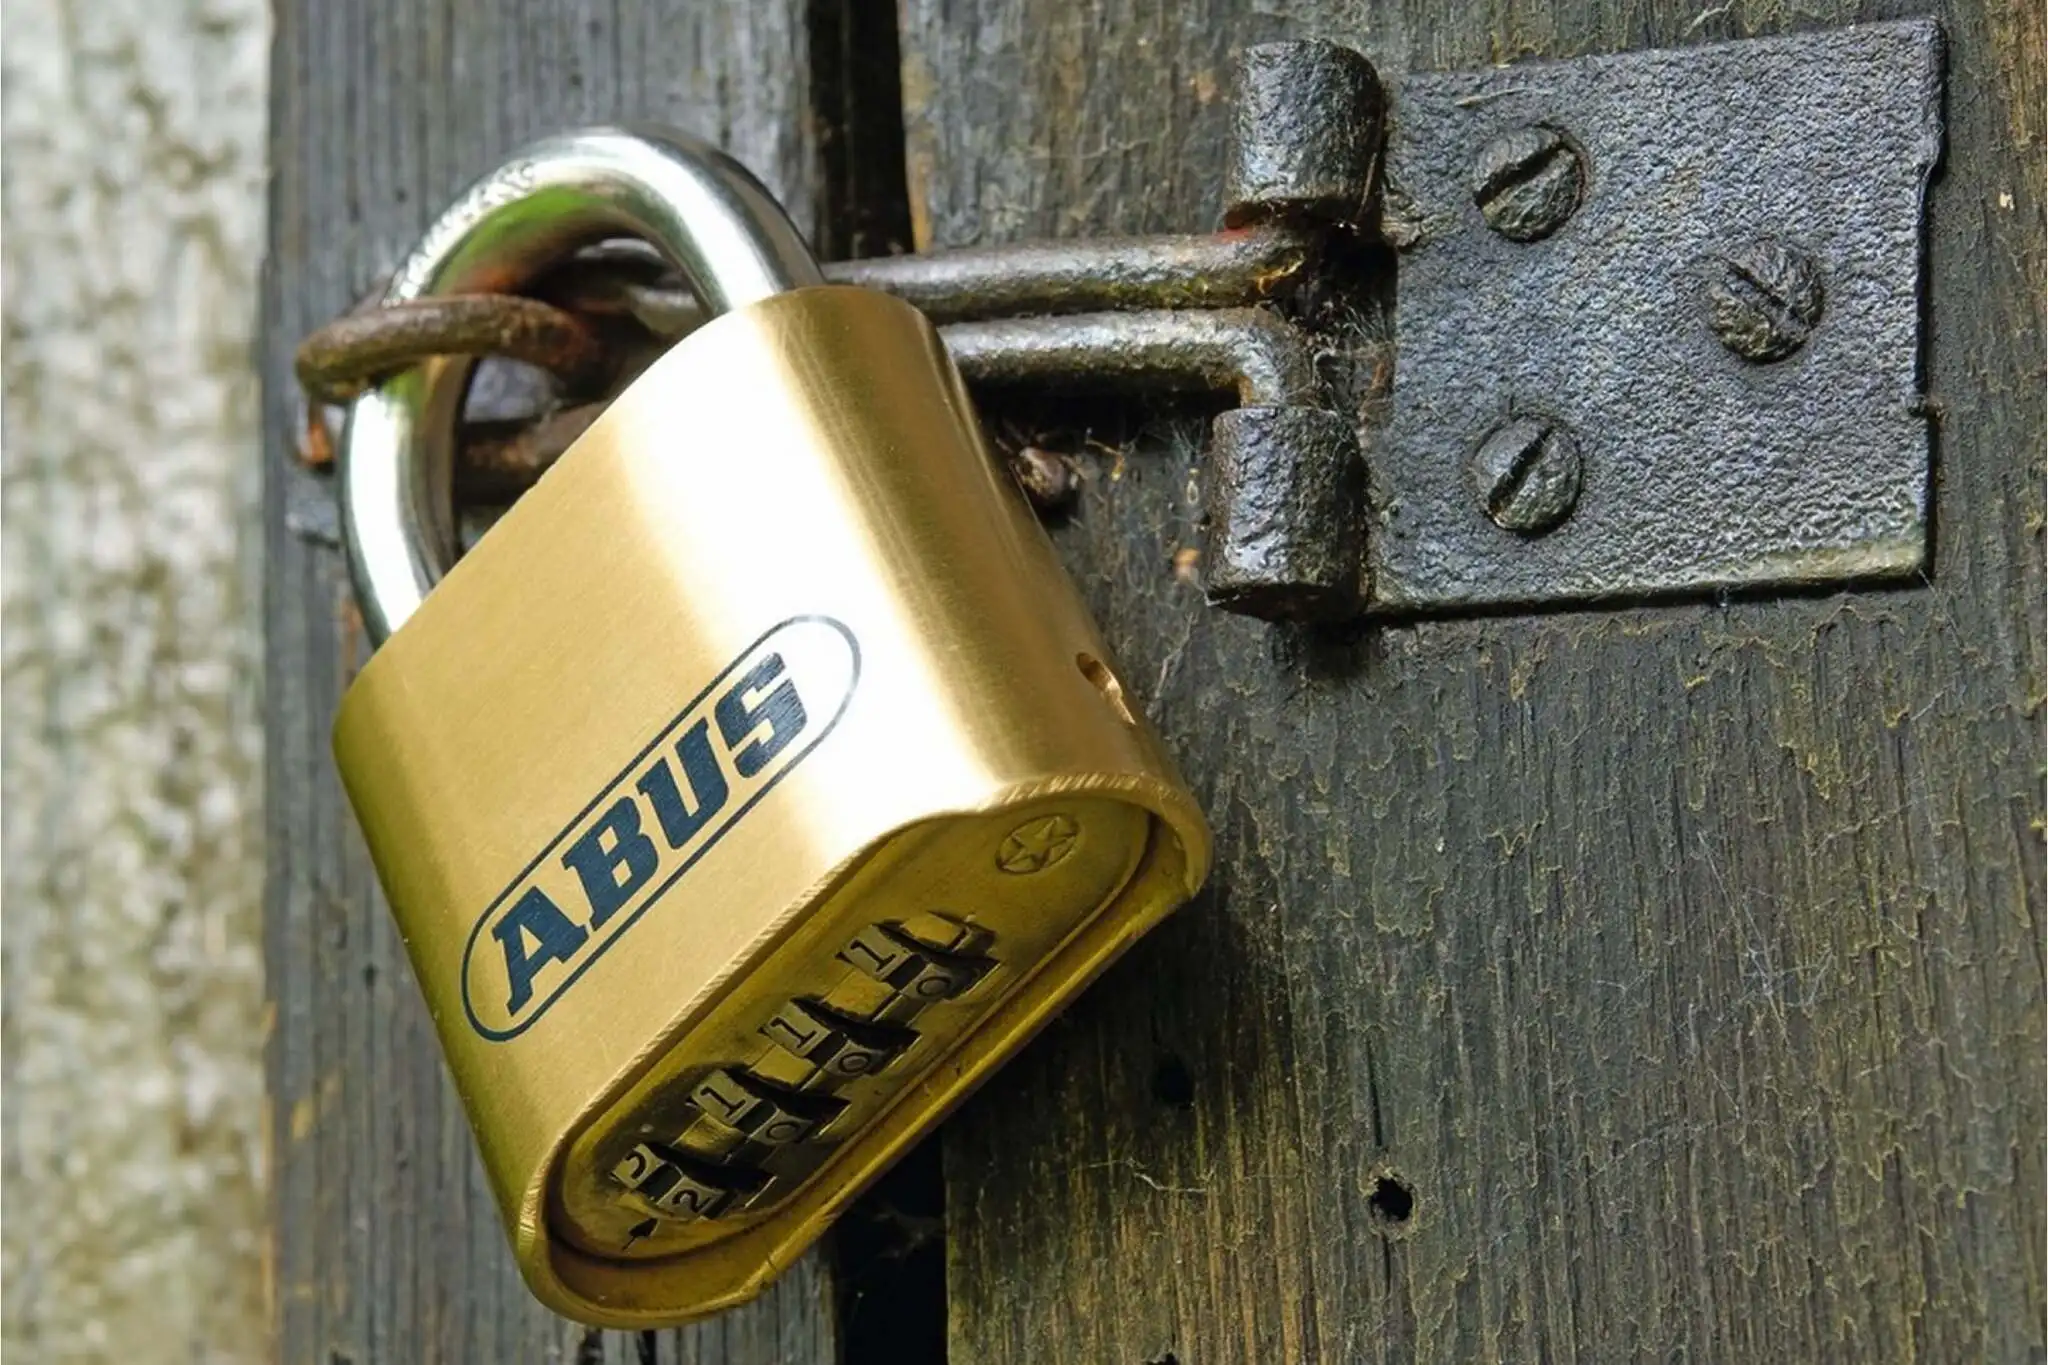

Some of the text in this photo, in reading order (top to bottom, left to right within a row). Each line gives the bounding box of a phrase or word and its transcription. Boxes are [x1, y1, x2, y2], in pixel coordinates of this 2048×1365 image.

[491, 652, 808, 1017] ABUS
[701, 1086, 746, 1117] 1
[769, 1016, 818, 1049] 1
[850, 939, 897, 973] 1
[672, 1188, 711, 1213] 2
